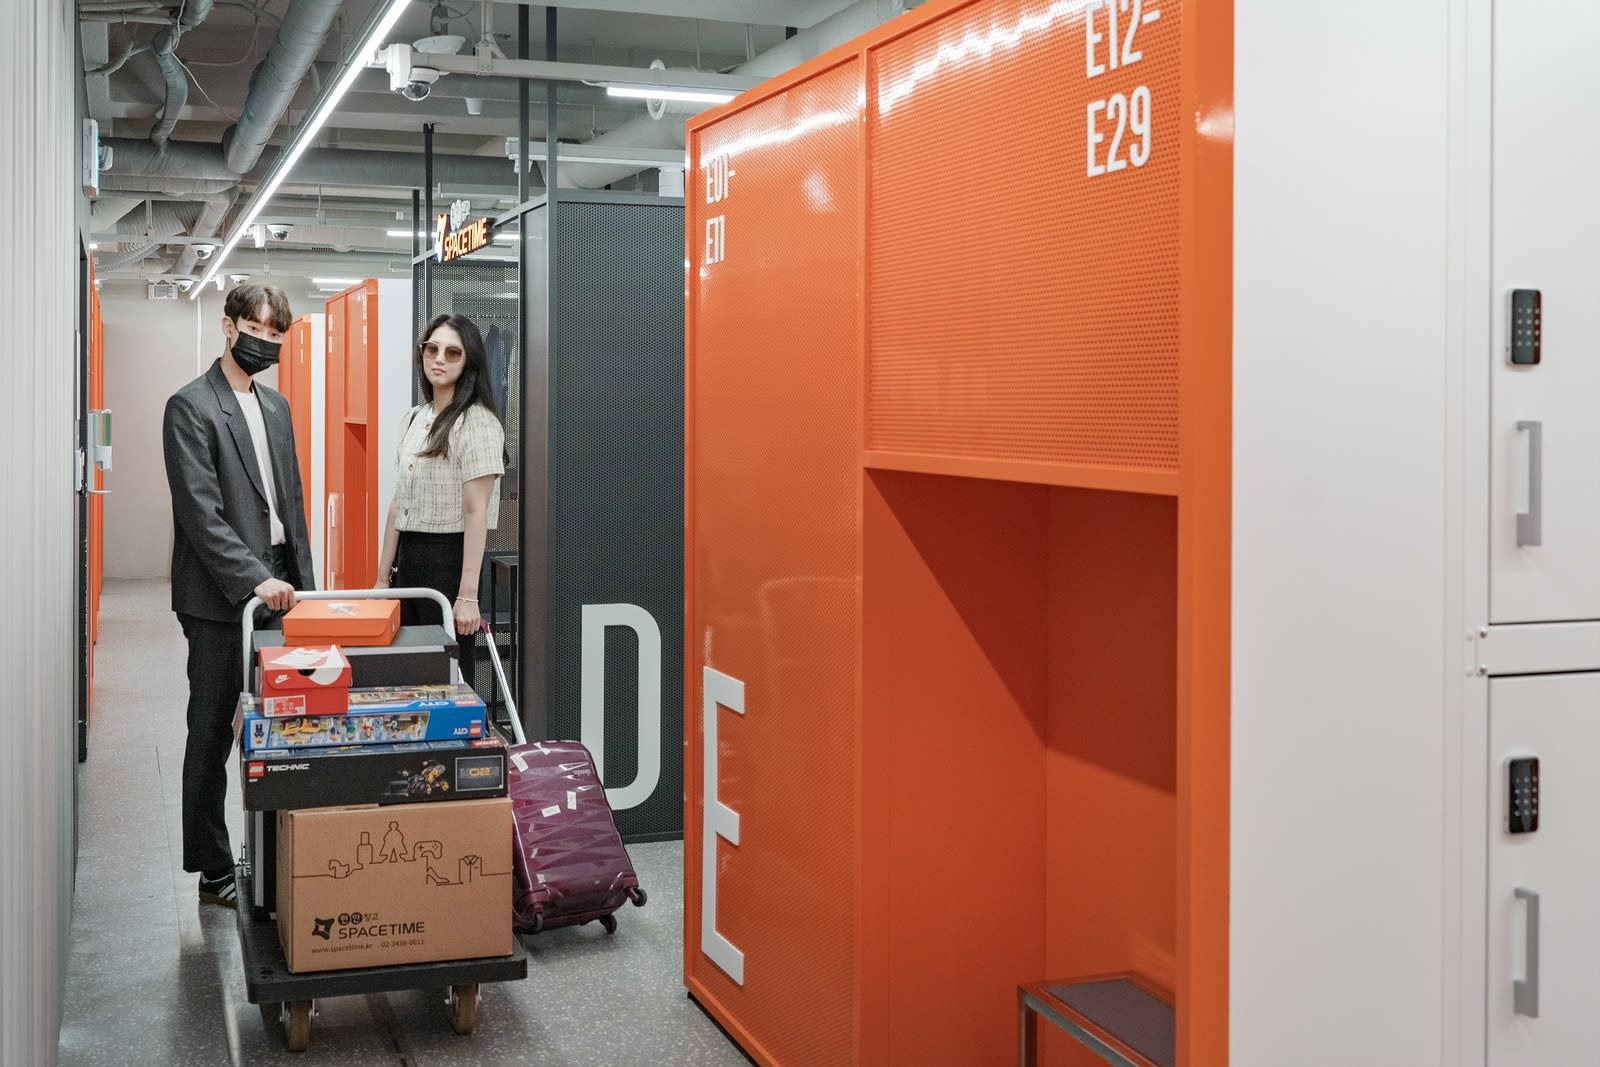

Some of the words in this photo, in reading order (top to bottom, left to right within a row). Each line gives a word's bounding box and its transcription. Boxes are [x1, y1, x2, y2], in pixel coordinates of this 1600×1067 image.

[1085, 0, 1161, 79] E12-
[1087, 85, 1151, 178] E29
[444, 216, 487, 262] SPACETIME
[705, 214, 726, 265] E11
[581, 603, 661, 810] D
[266, 763, 310, 772] TECHNIC
[701, 666, 745, 986] E
[311, 943, 373, 954] www.spacetime.kr
[338, 921, 425, 939] SPACETIME
